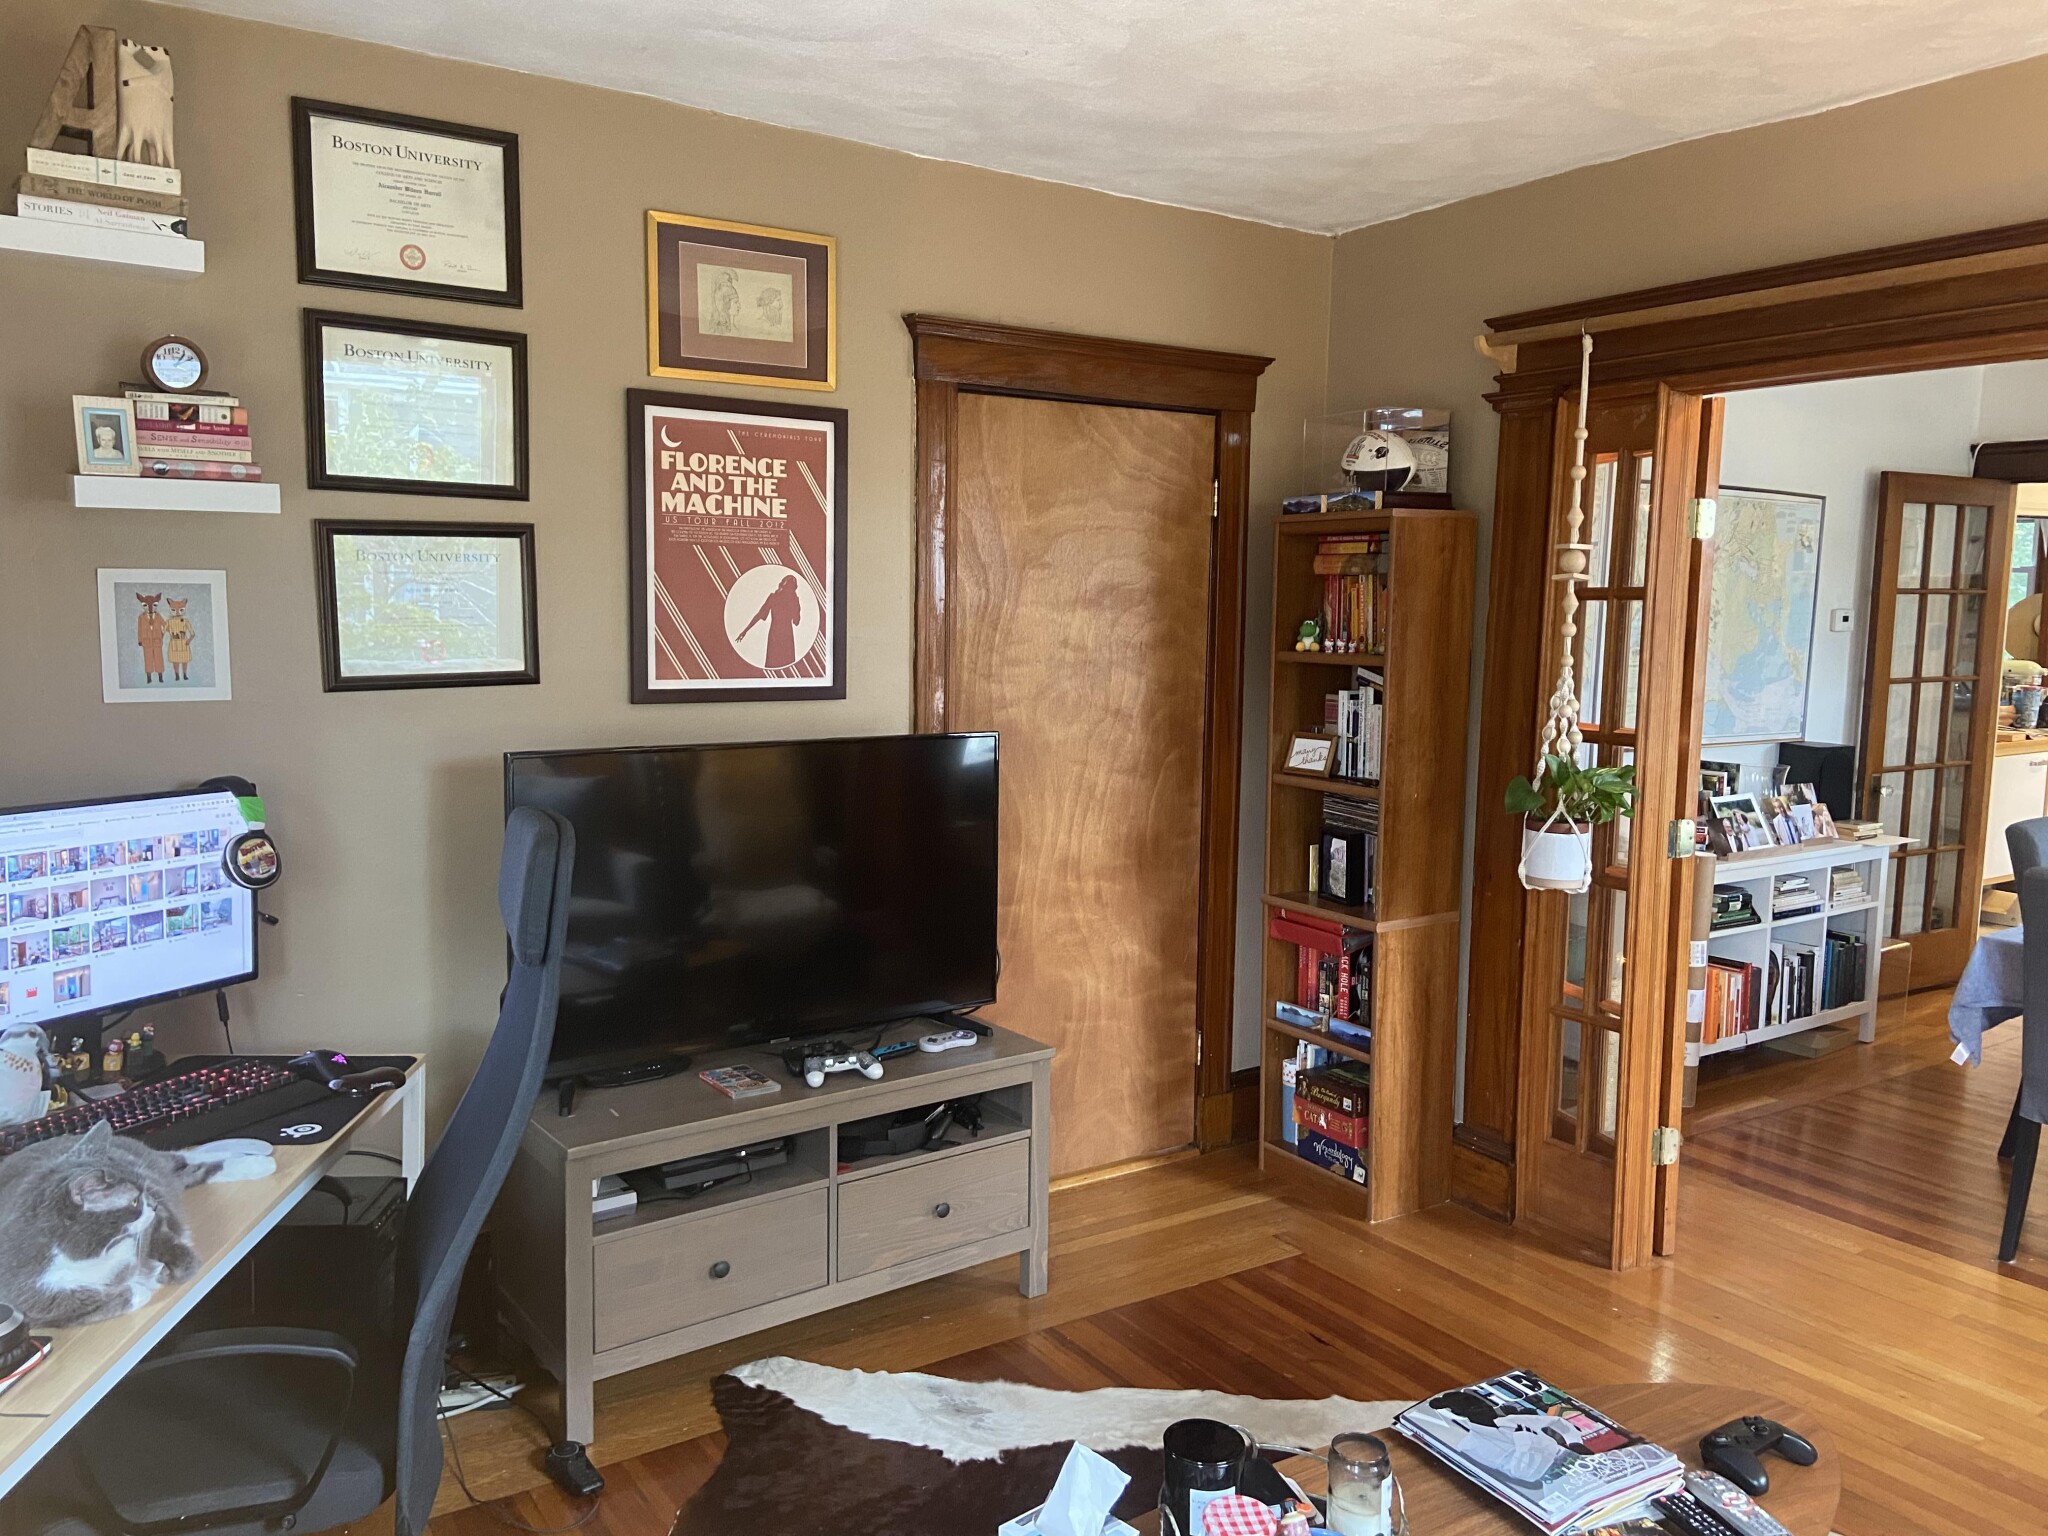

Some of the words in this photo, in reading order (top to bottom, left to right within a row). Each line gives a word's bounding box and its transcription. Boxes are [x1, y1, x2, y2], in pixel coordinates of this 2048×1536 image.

[331, 134, 393, 157] BOSTON
[395, 144, 482, 171] UNIVERSITY
[23, 201, 73, 216] STORIES
[66, 186, 83, 196] THE
[87, 189, 123, 201] WORLD
[123, 194, 134, 203] OF
[136, 196, 162, 208] POOH
[97, 207, 113, 217] Neil
[115, 211, 146, 222] Gaiman
[343, 343, 404, 362] BOSTON
[407, 350, 493, 371] UNIVERSITY
[150, 432, 178, 442] SENSE
[661, 450, 788, 478] FLORENCE
[670, 472, 725, 494] AND
[728, 475, 779, 497] THE
[661, 491, 788, 519] MACHINE
[665, 516, 678, 524] US
[687, 516, 717, 526] TOUR
[726, 518, 751, 528] FALL
[759, 520, 786, 529] 2012
[355, 549, 415, 563] BOSTON
[417, 549, 502, 563] UNIVERSITY
[1340, 972, 1349, 993] HOLE
[1311, 1085, 1340, 1108] Burgundy
[1313, 1138, 1354, 1170] Wizardology
[1561, 1452, 1612, 1477] HOPE
